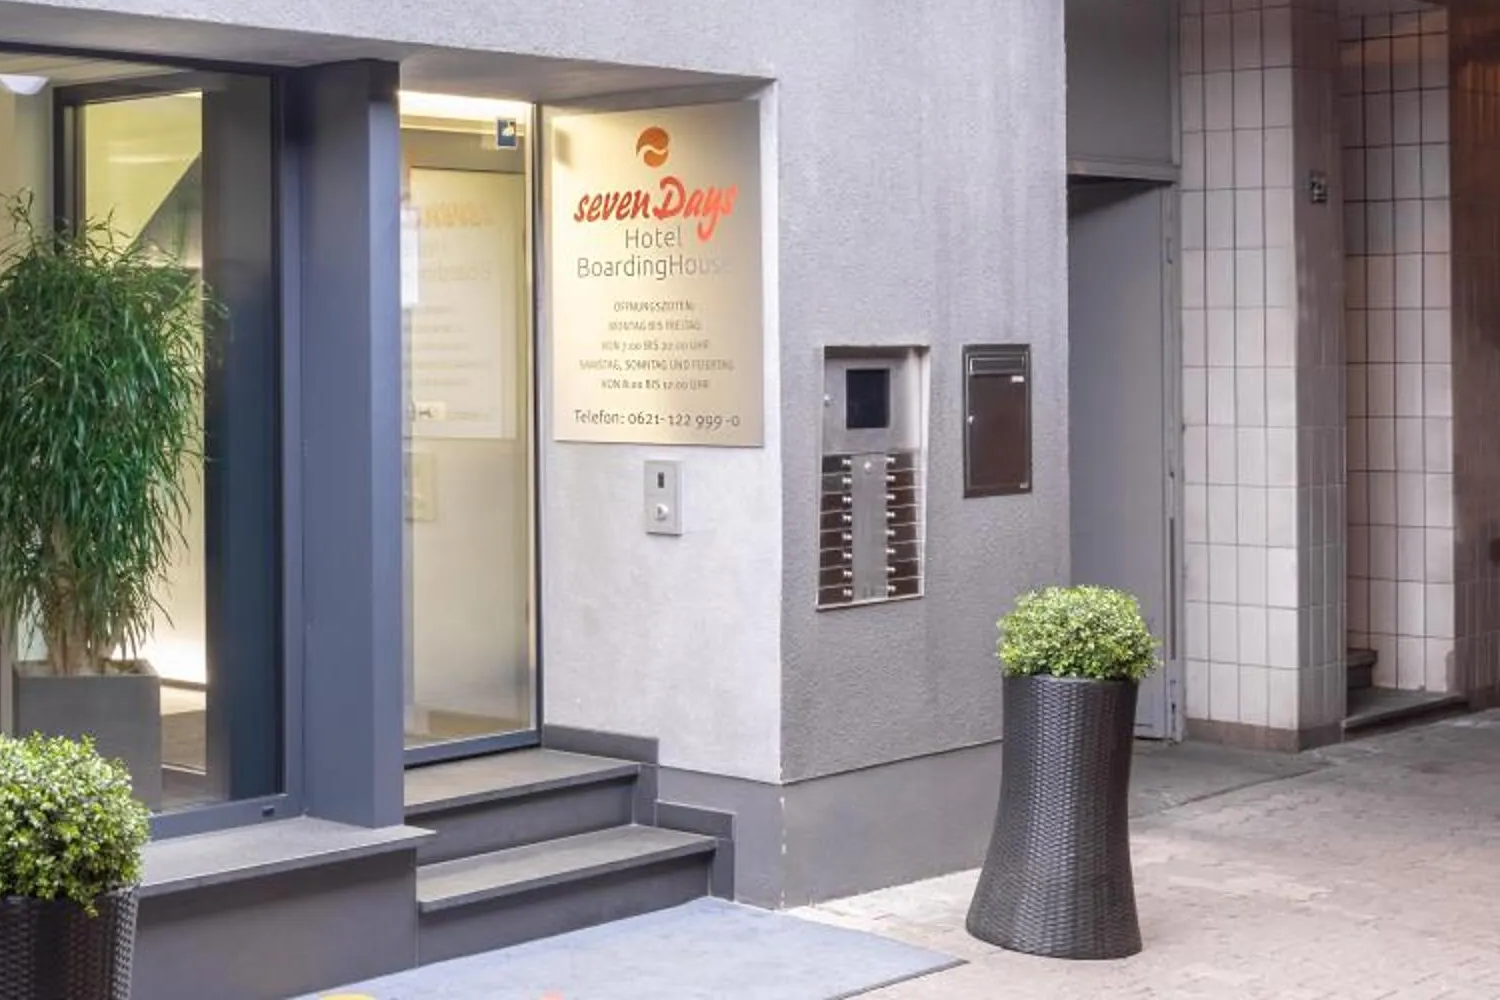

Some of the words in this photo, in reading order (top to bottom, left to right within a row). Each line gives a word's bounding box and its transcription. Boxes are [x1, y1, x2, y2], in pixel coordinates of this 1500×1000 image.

[625, 226, 682, 248] Hotel
[577, 254, 731, 281] BoardingHous
[574, 409, 625, 425] Telefon:
